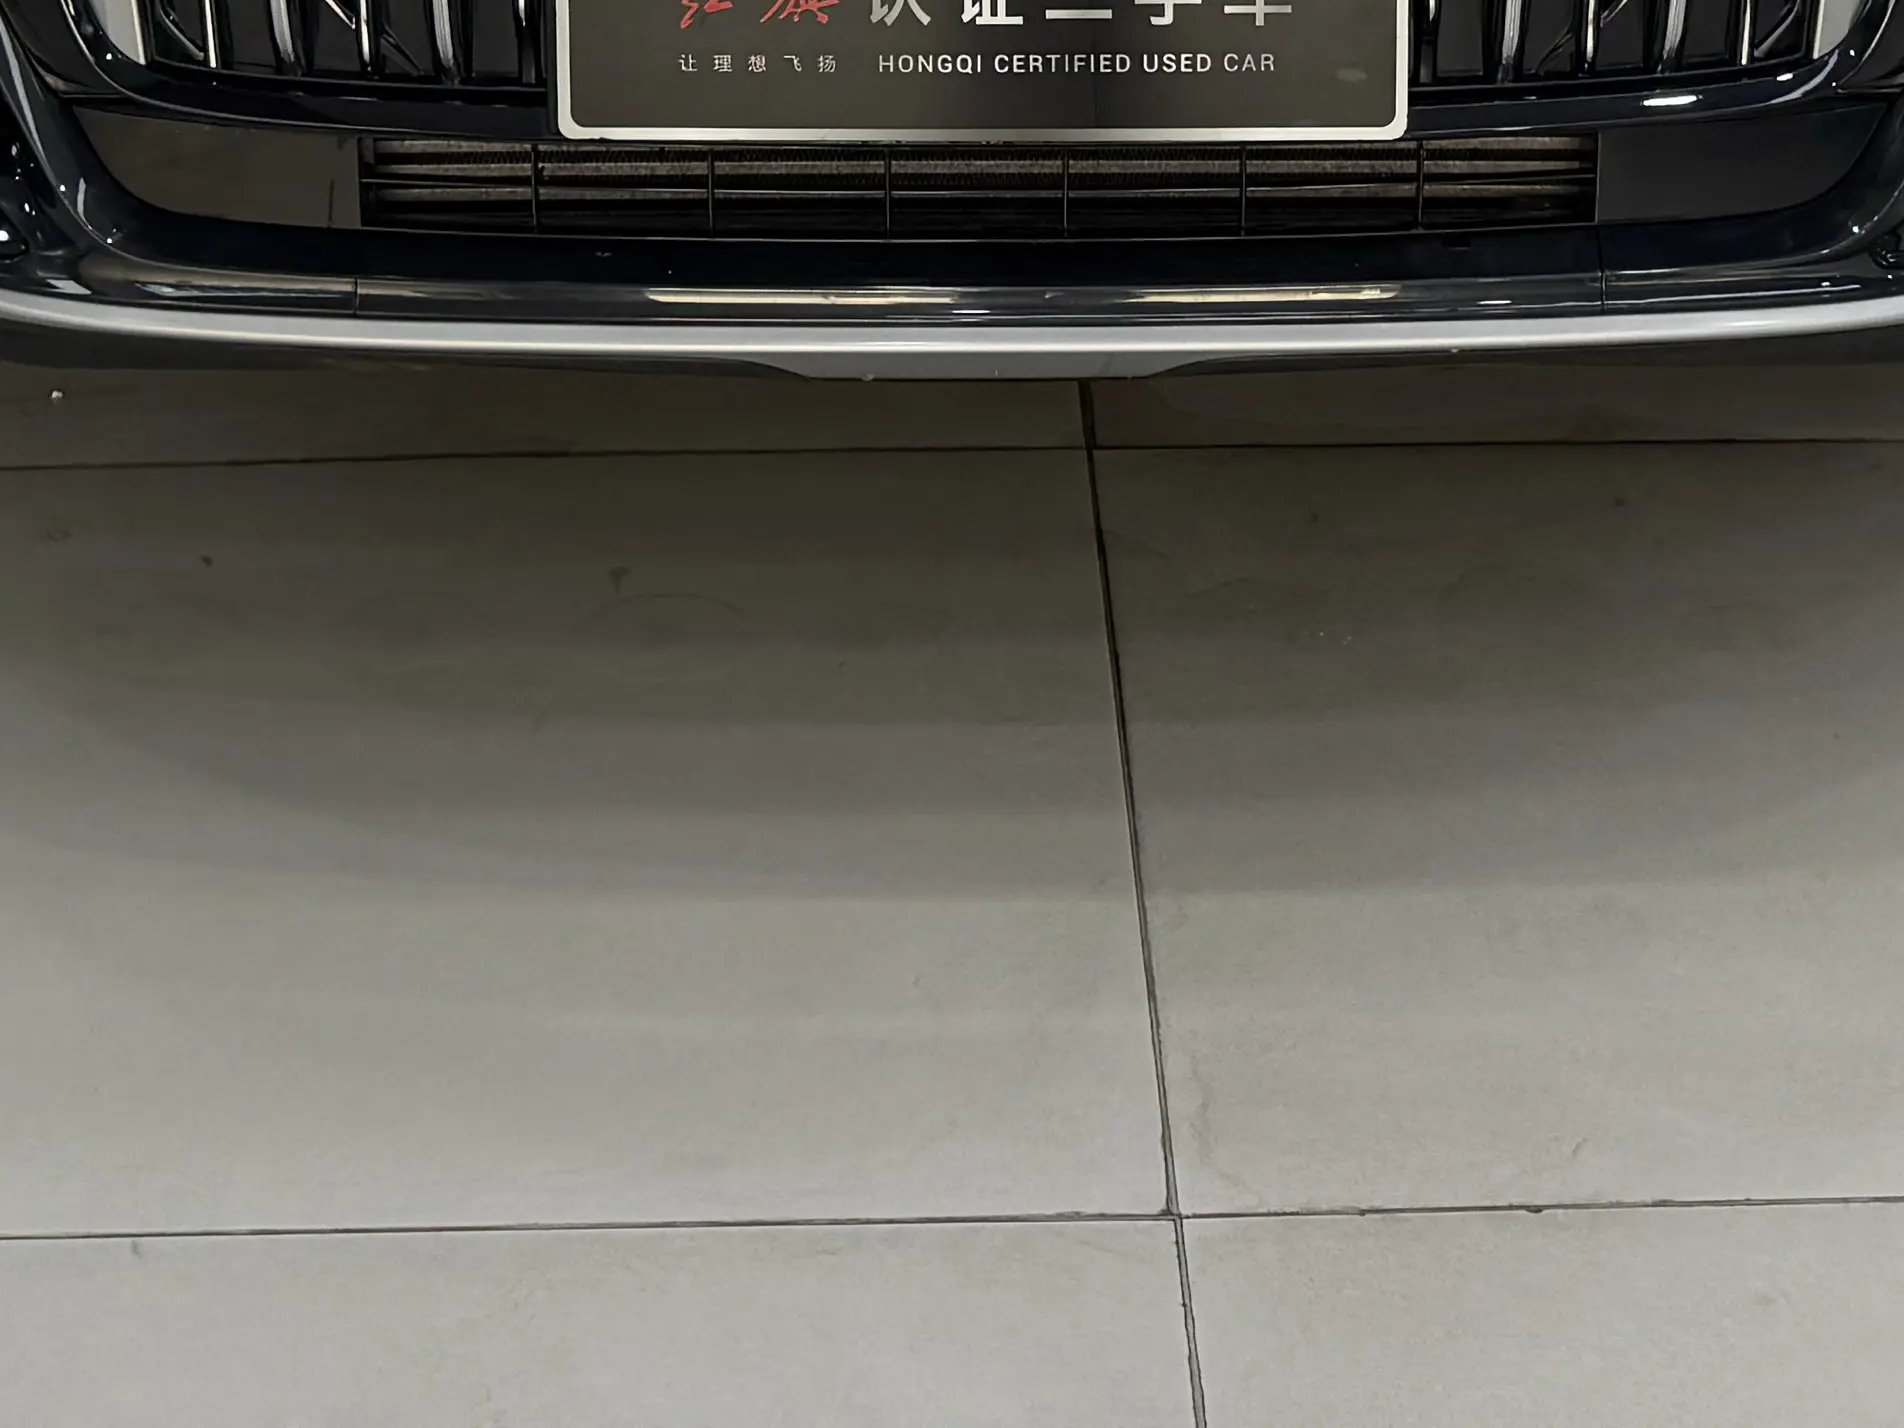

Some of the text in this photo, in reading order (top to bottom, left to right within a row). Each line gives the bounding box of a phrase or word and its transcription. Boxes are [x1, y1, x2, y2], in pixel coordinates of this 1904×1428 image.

[678, 53, 836, 74] 让理想飞扬
[879, 53, 1274, 75] HONGQI CERTIFIED USED CAR
